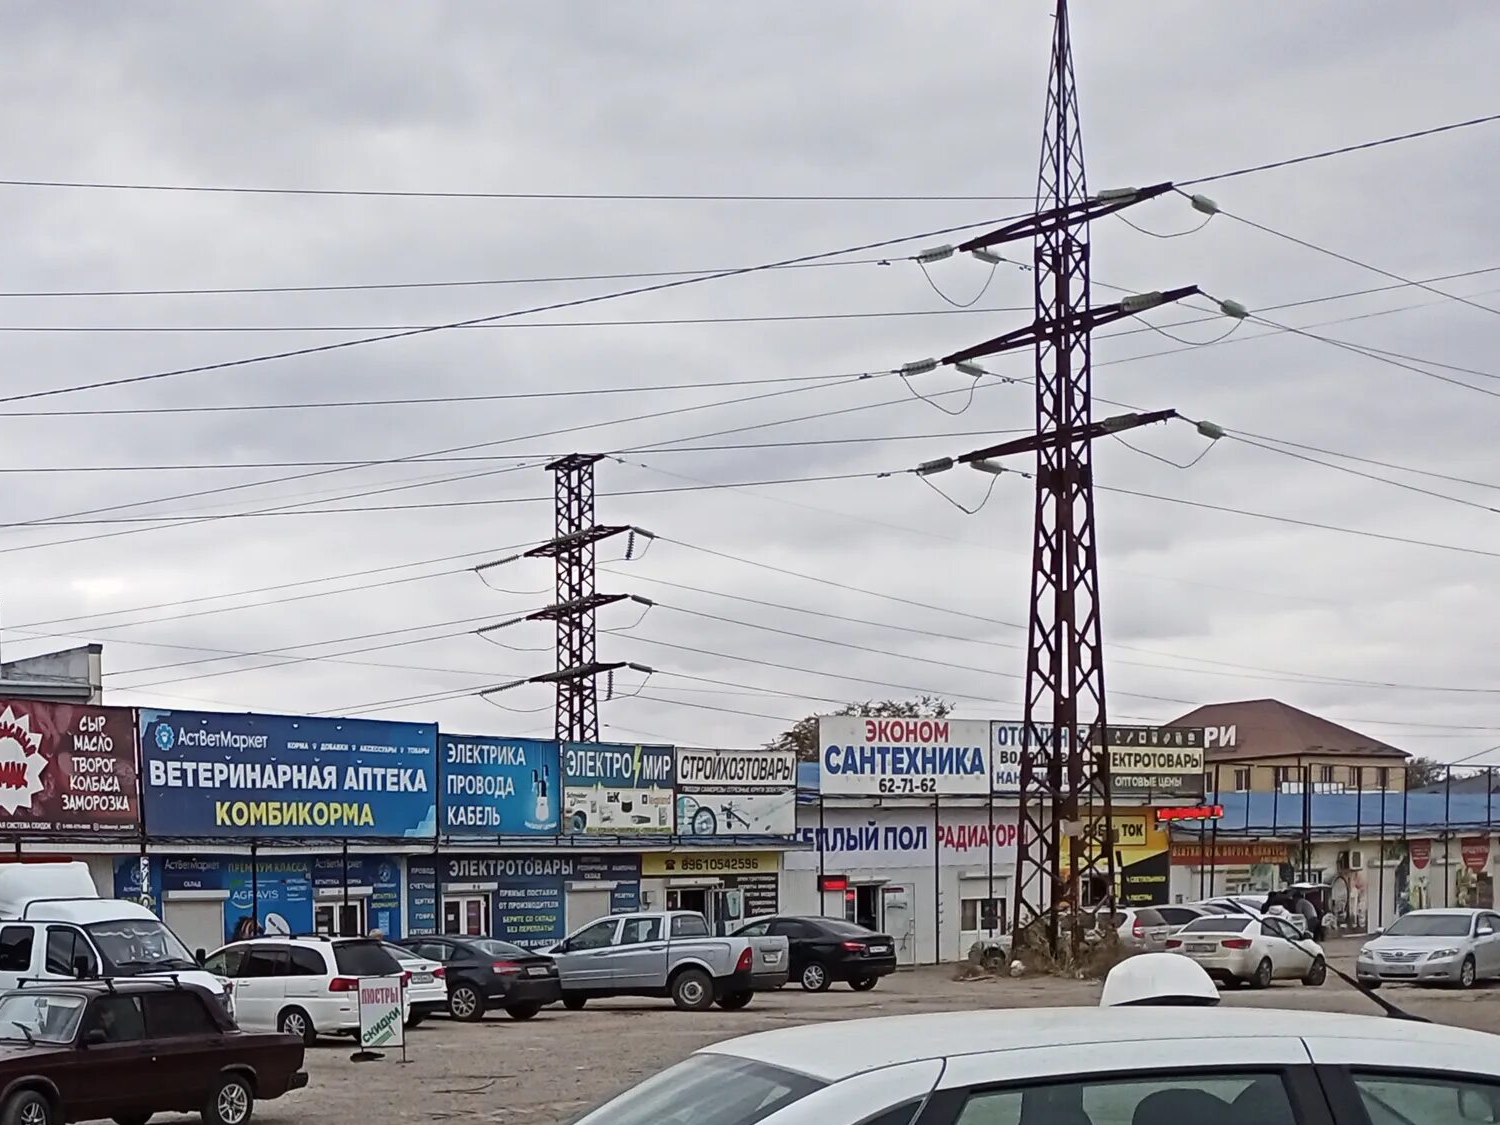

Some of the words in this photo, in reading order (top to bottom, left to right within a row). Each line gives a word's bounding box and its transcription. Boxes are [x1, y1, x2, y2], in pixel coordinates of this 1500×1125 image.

[78, 715, 106, 732] СЫР
[865, 720, 949, 743] ЭКОНОМ
[73, 735, 113, 752] МАСЛО
[178, 730, 268, 751] АстВетМаркет
[72, 757, 116, 773] ТВОРОГ
[447, 743, 526, 767] ЭЛЕКТРИКА
[566, 749, 632, 777] ЭЛЕКТРО
[642, 753, 672, 781] МИР
[824, 746, 985, 775] САНТЕХНИКА
[1095, 751, 1202, 769] ЕКТРОТОВАРЫ
[149, 760, 338, 790] ВЕТЕРИНАРНАЯ
[343, 767, 428, 792] АПТЕКА
[681, 755, 795, 781] СТРОЙХОЗТОВАРЫ
[69, 775, 121, 791] КОЛБАСА
[447, 775, 514, 797] ПРОВОДА
[878, 778, 937, 793] 62-71-62
[1114, 776, 1156, 787] ОПТОВЫЕ
[1158, 776, 1182, 788] ЦЕНЫ
[61, 795, 130, 812] ЗАМОРОЗКА
[215, 801, 374, 826] КОМБИКОРМА
[447, 805, 501, 827] КАБЕЛЬ
[884, 826, 927, 850] ПОЛ
[274, 862, 308, 872] КЛАССА
[449, 859, 573, 877] ЭЛЕКТРОТОВАРЫ
[361, 987, 399, 1004] ЛЮСТРЫ
[362, 1007, 401, 1043] СКИДКИ
